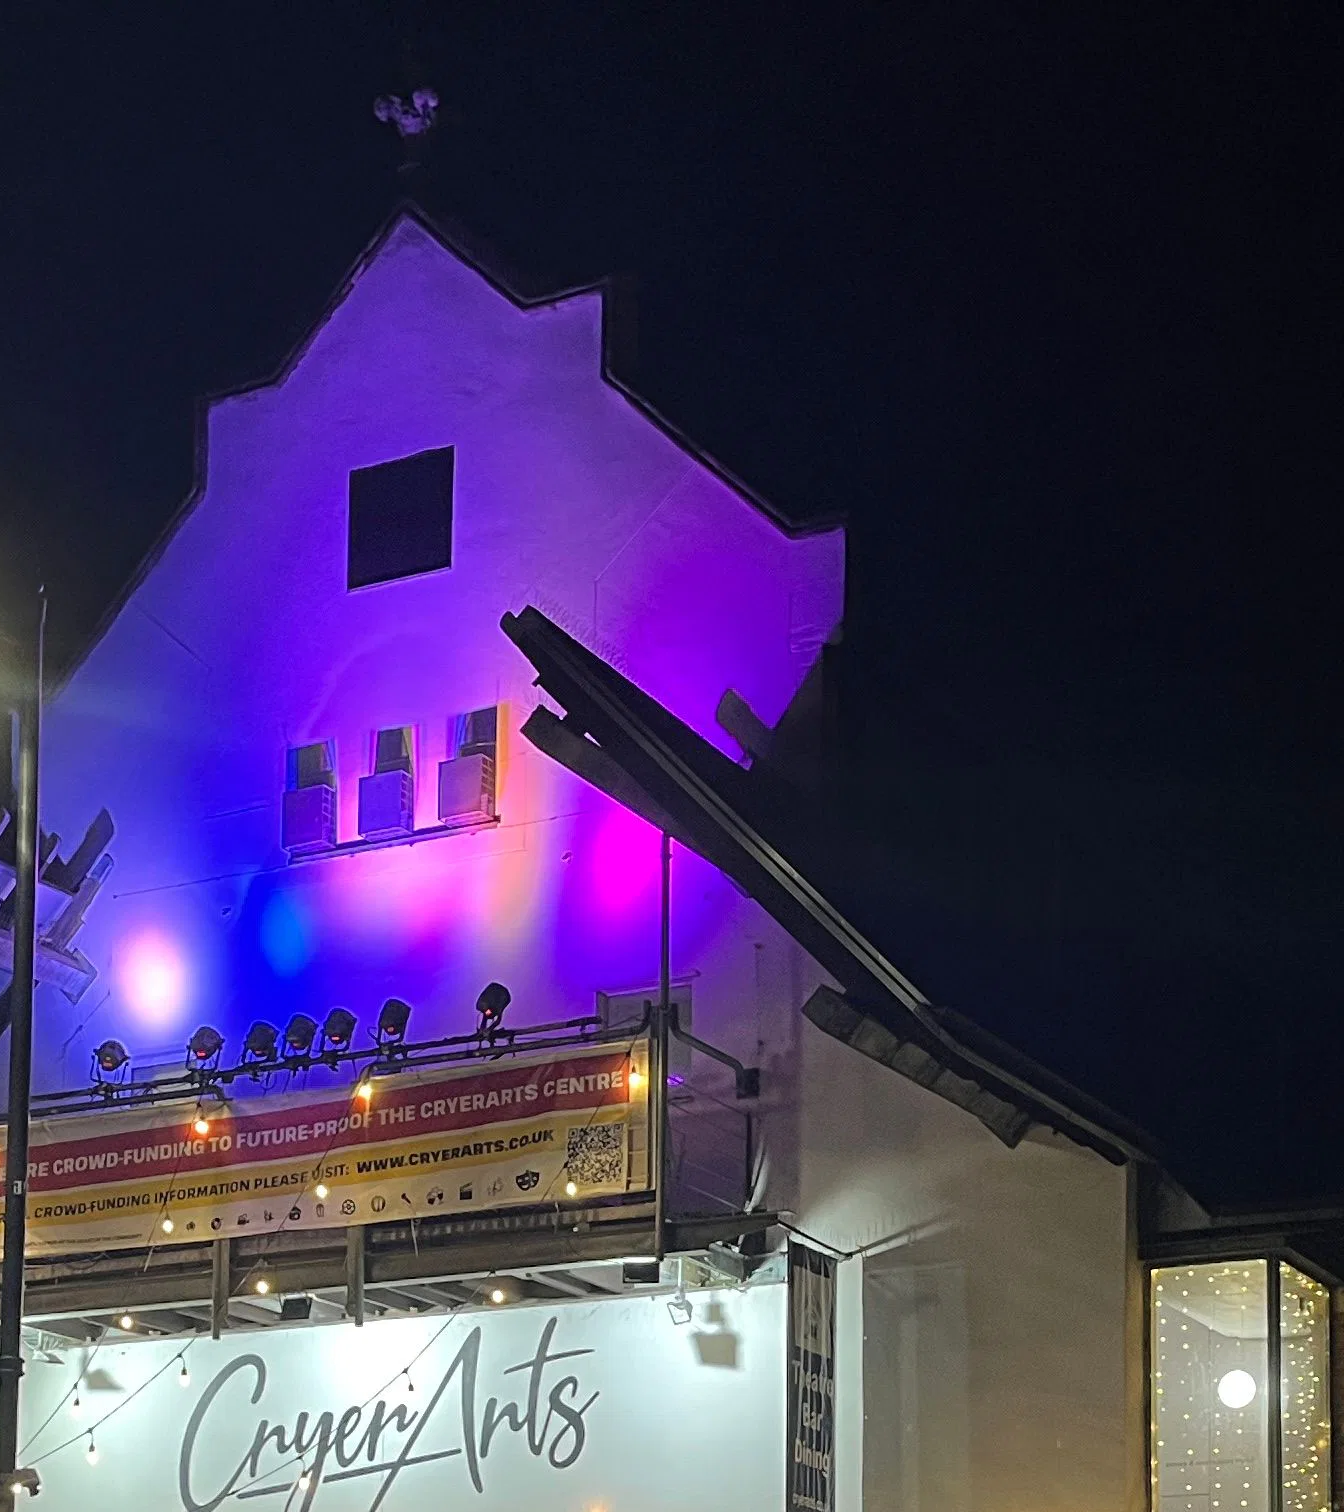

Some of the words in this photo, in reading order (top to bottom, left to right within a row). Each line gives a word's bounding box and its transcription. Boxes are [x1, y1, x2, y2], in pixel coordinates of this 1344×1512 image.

[52, 1136, 205, 1174] CROWD-FUNDING
[208, 1135, 233, 1152] TO
[236, 1113, 373, 1149] FUTURE-PROOF
[377, 1103, 416, 1126] THE
[420, 1083, 538, 1122] CRYERARTS
[542, 1070, 624, 1097] CENTRE
[34, 1193, 151, 1219] CROWD-FUNDING
[154, 1178, 250, 1205] INFORMATION
[254, 1170, 309, 1191] PLEASE
[356, 1128, 555, 1175] WWW.CRYERARTS.CO.UK
[802, 1402, 823, 1432] Bar
[794, 1438, 832, 1478] Dining
